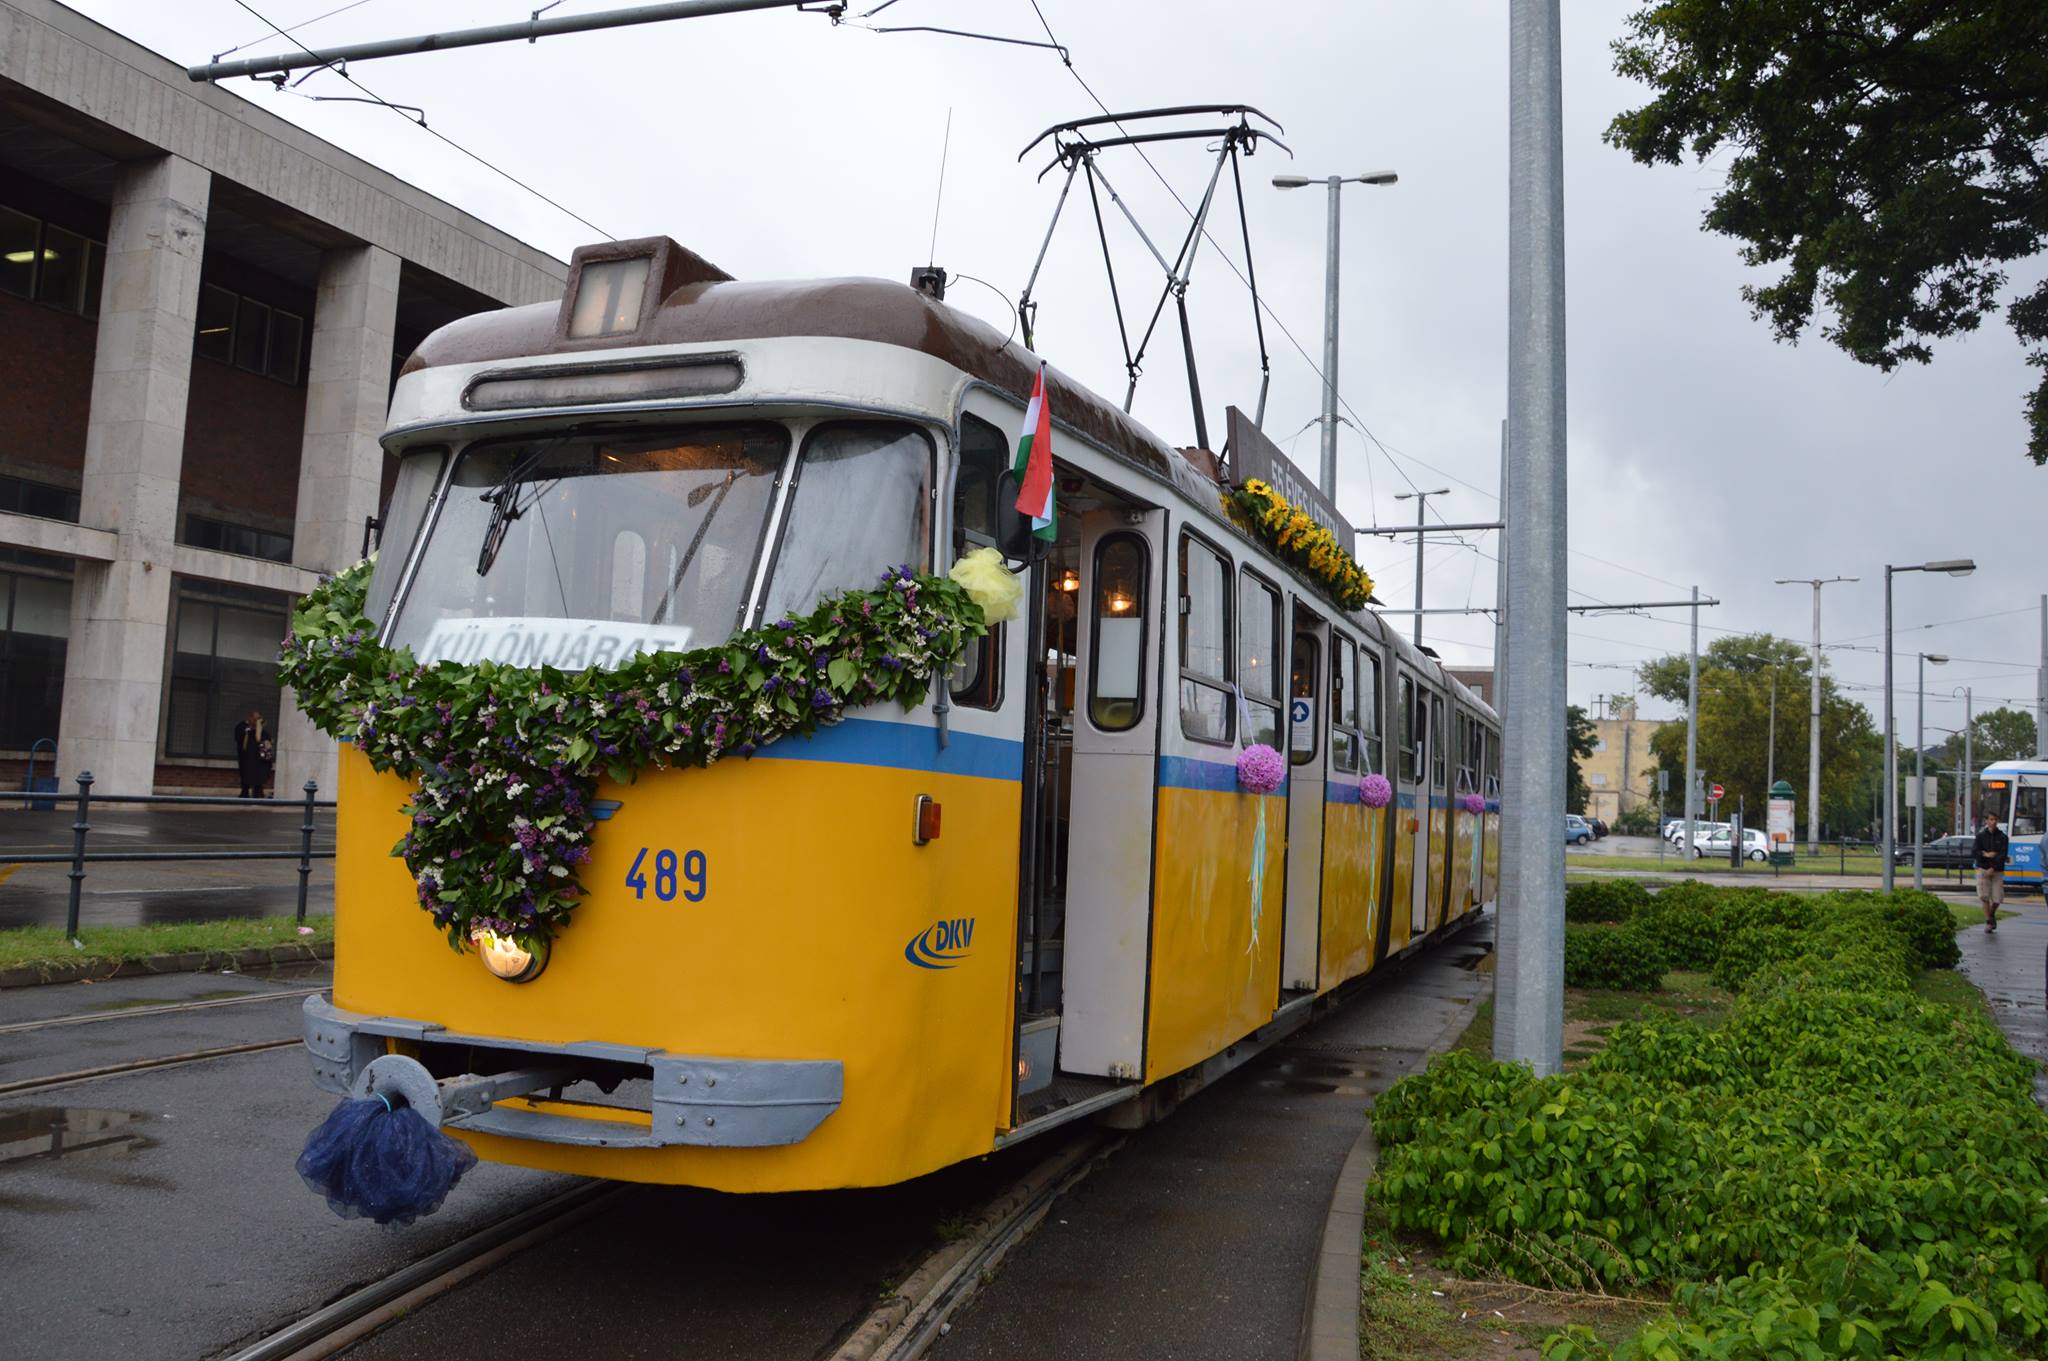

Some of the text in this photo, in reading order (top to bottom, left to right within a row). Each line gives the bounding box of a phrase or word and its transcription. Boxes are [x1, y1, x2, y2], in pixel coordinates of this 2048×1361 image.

[599, 261, 625, 335] 1
[625, 847, 707, 902] 489
[935, 917, 975, 952] DKV
